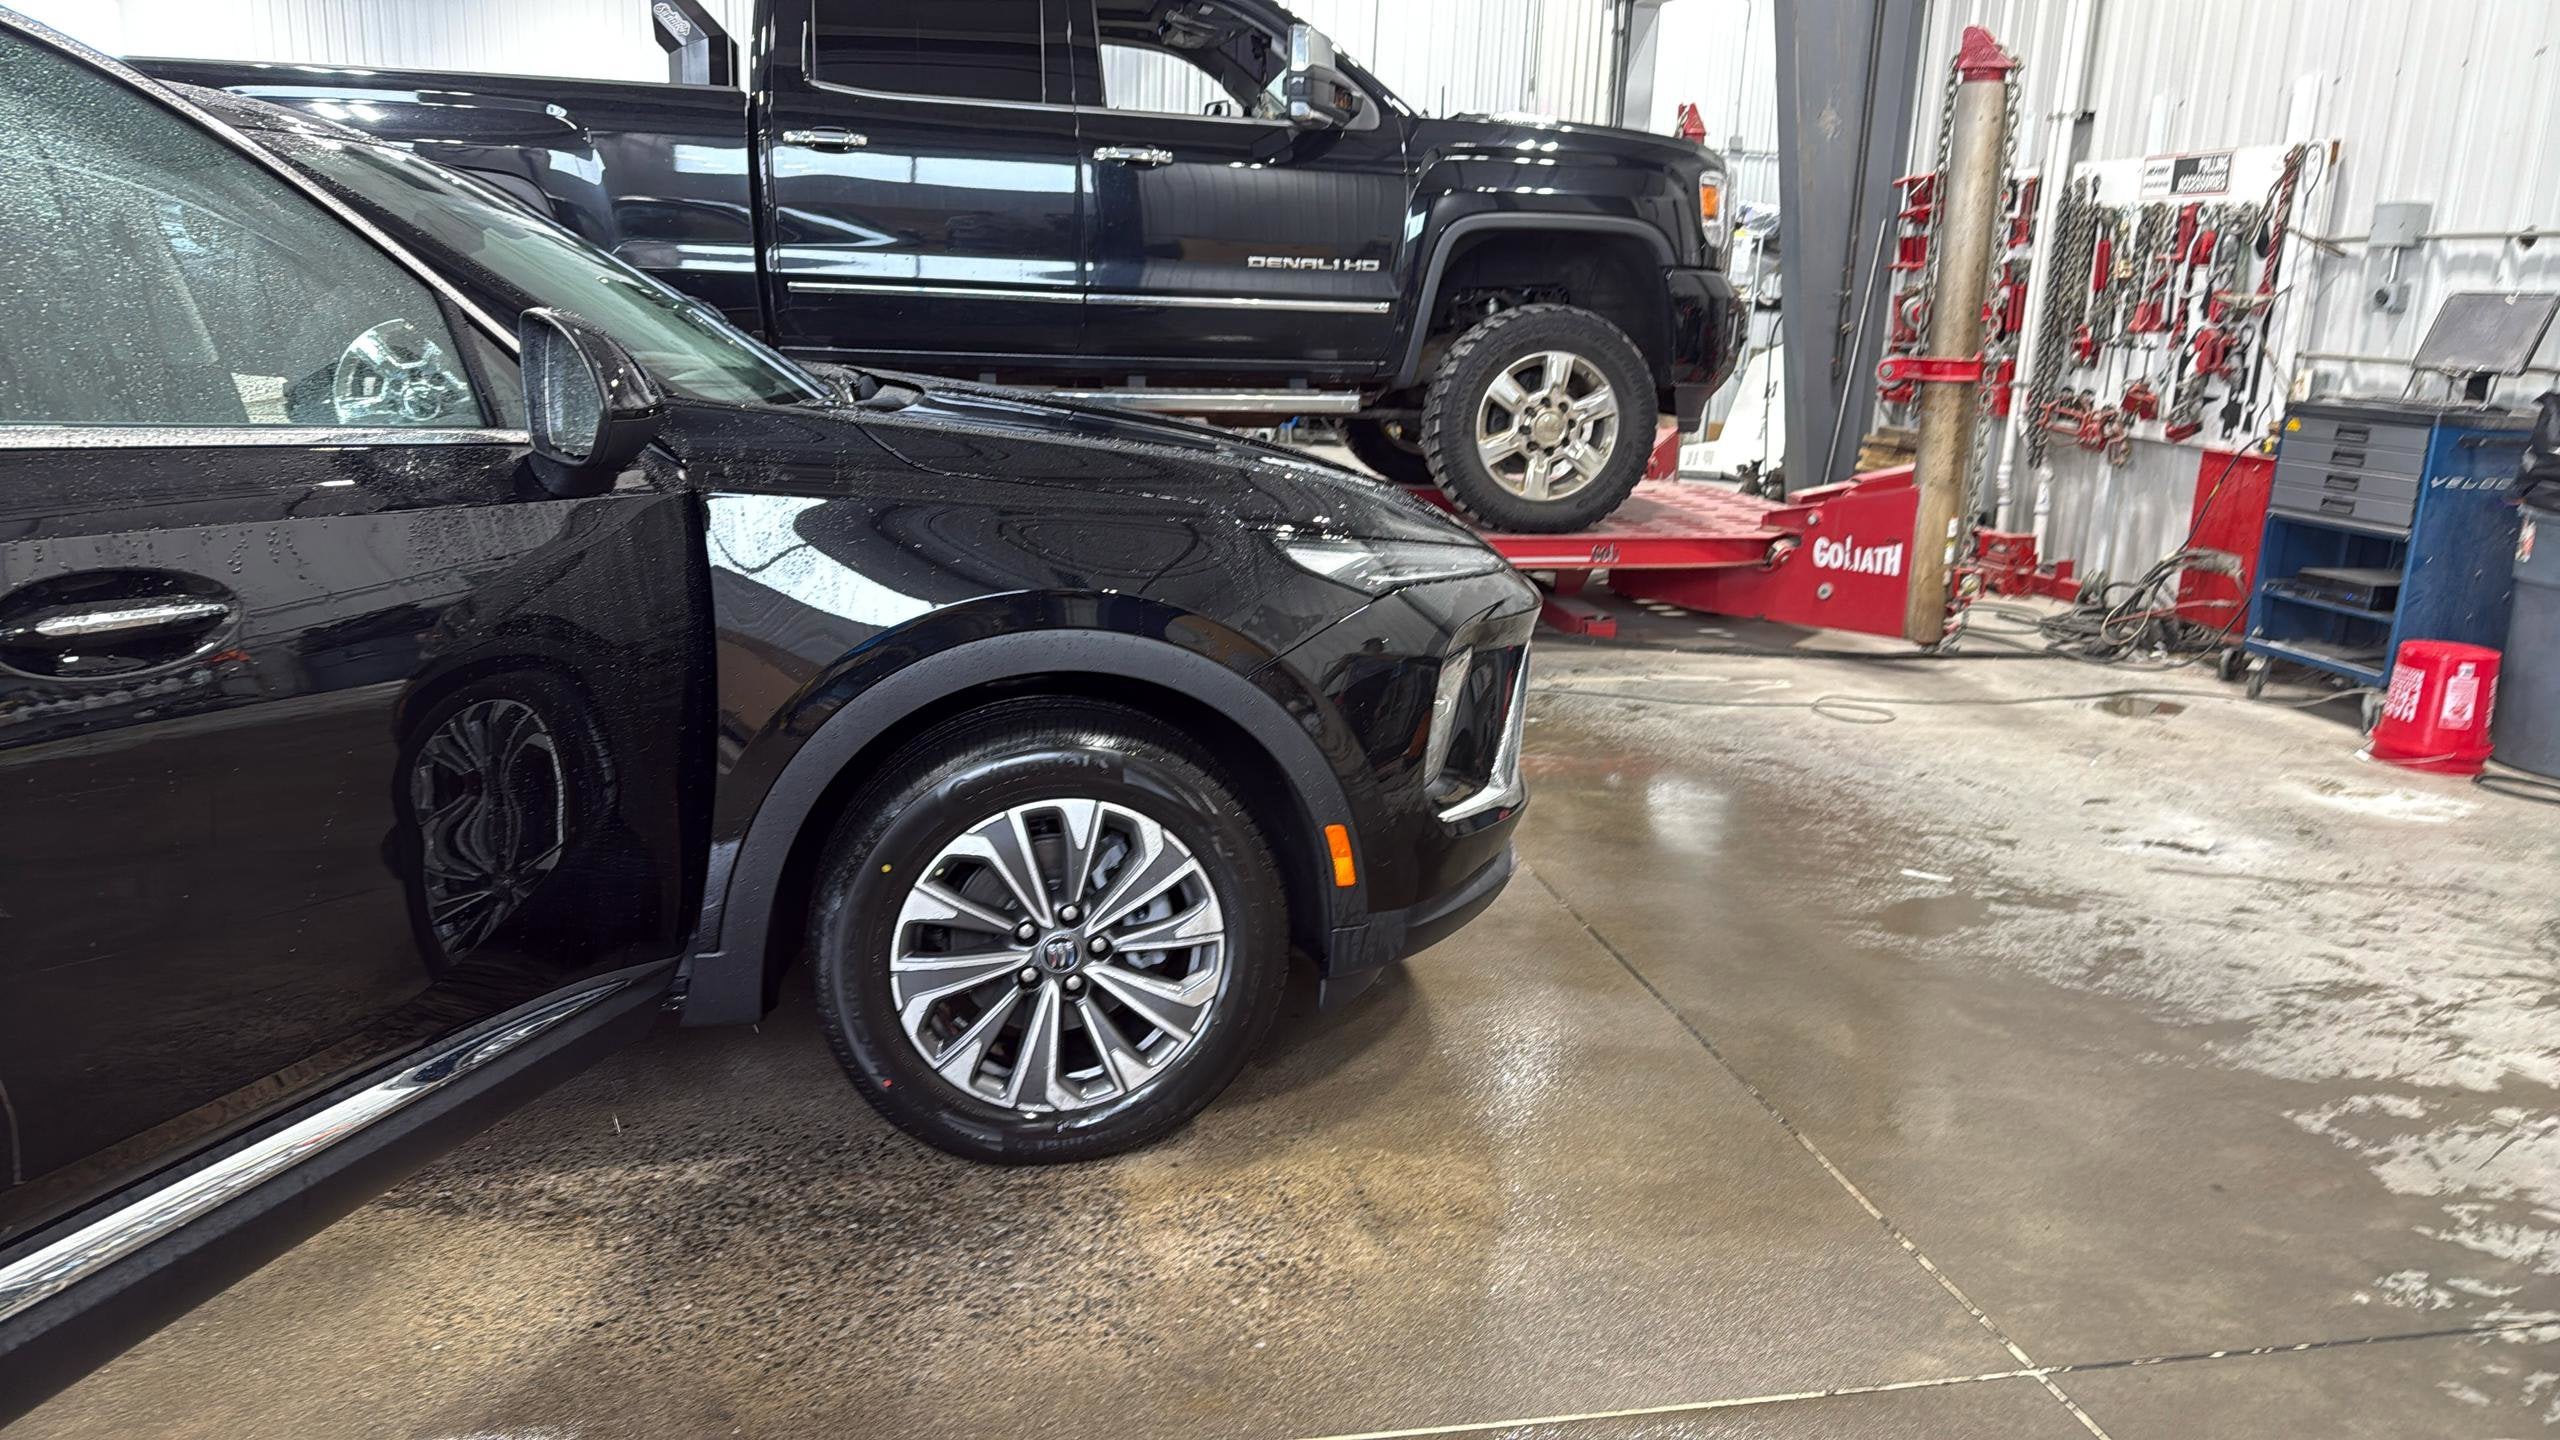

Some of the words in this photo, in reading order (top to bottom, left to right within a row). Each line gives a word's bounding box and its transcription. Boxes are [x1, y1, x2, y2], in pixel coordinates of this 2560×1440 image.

[1248, 255, 1339, 270] DENALI
[1344, 259, 1380, 271] HD
[1813, 534, 1903, 577] GOLIATH
